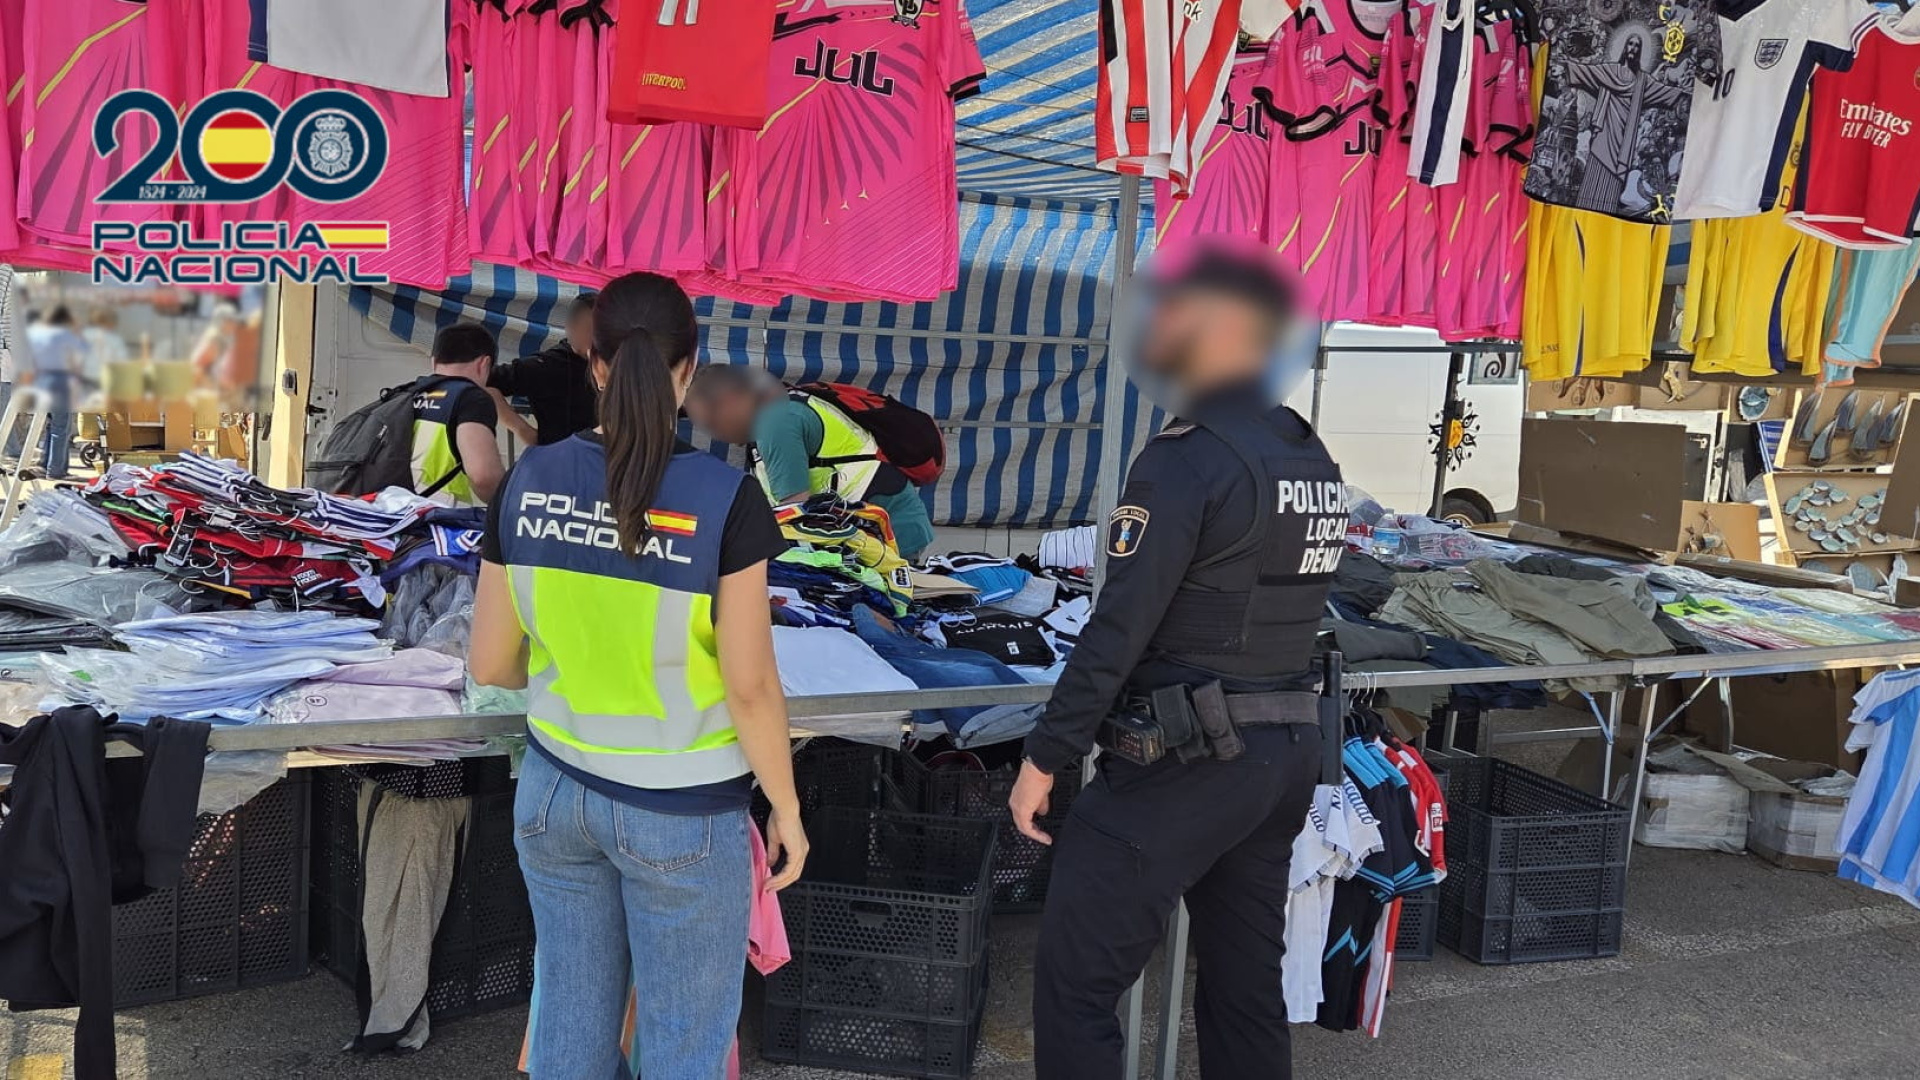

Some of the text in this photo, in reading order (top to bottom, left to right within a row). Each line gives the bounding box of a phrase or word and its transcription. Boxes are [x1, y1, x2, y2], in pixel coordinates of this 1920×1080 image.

[642, 73, 686, 90] LIVERPOO
[794, 34, 895, 97] JUL
[1840, 98, 1912, 136] Emirates
[1841, 121, 1863, 139] FLY
[520, 491, 651, 530] POLIC
[516, 515, 692, 565] NACIOAL
